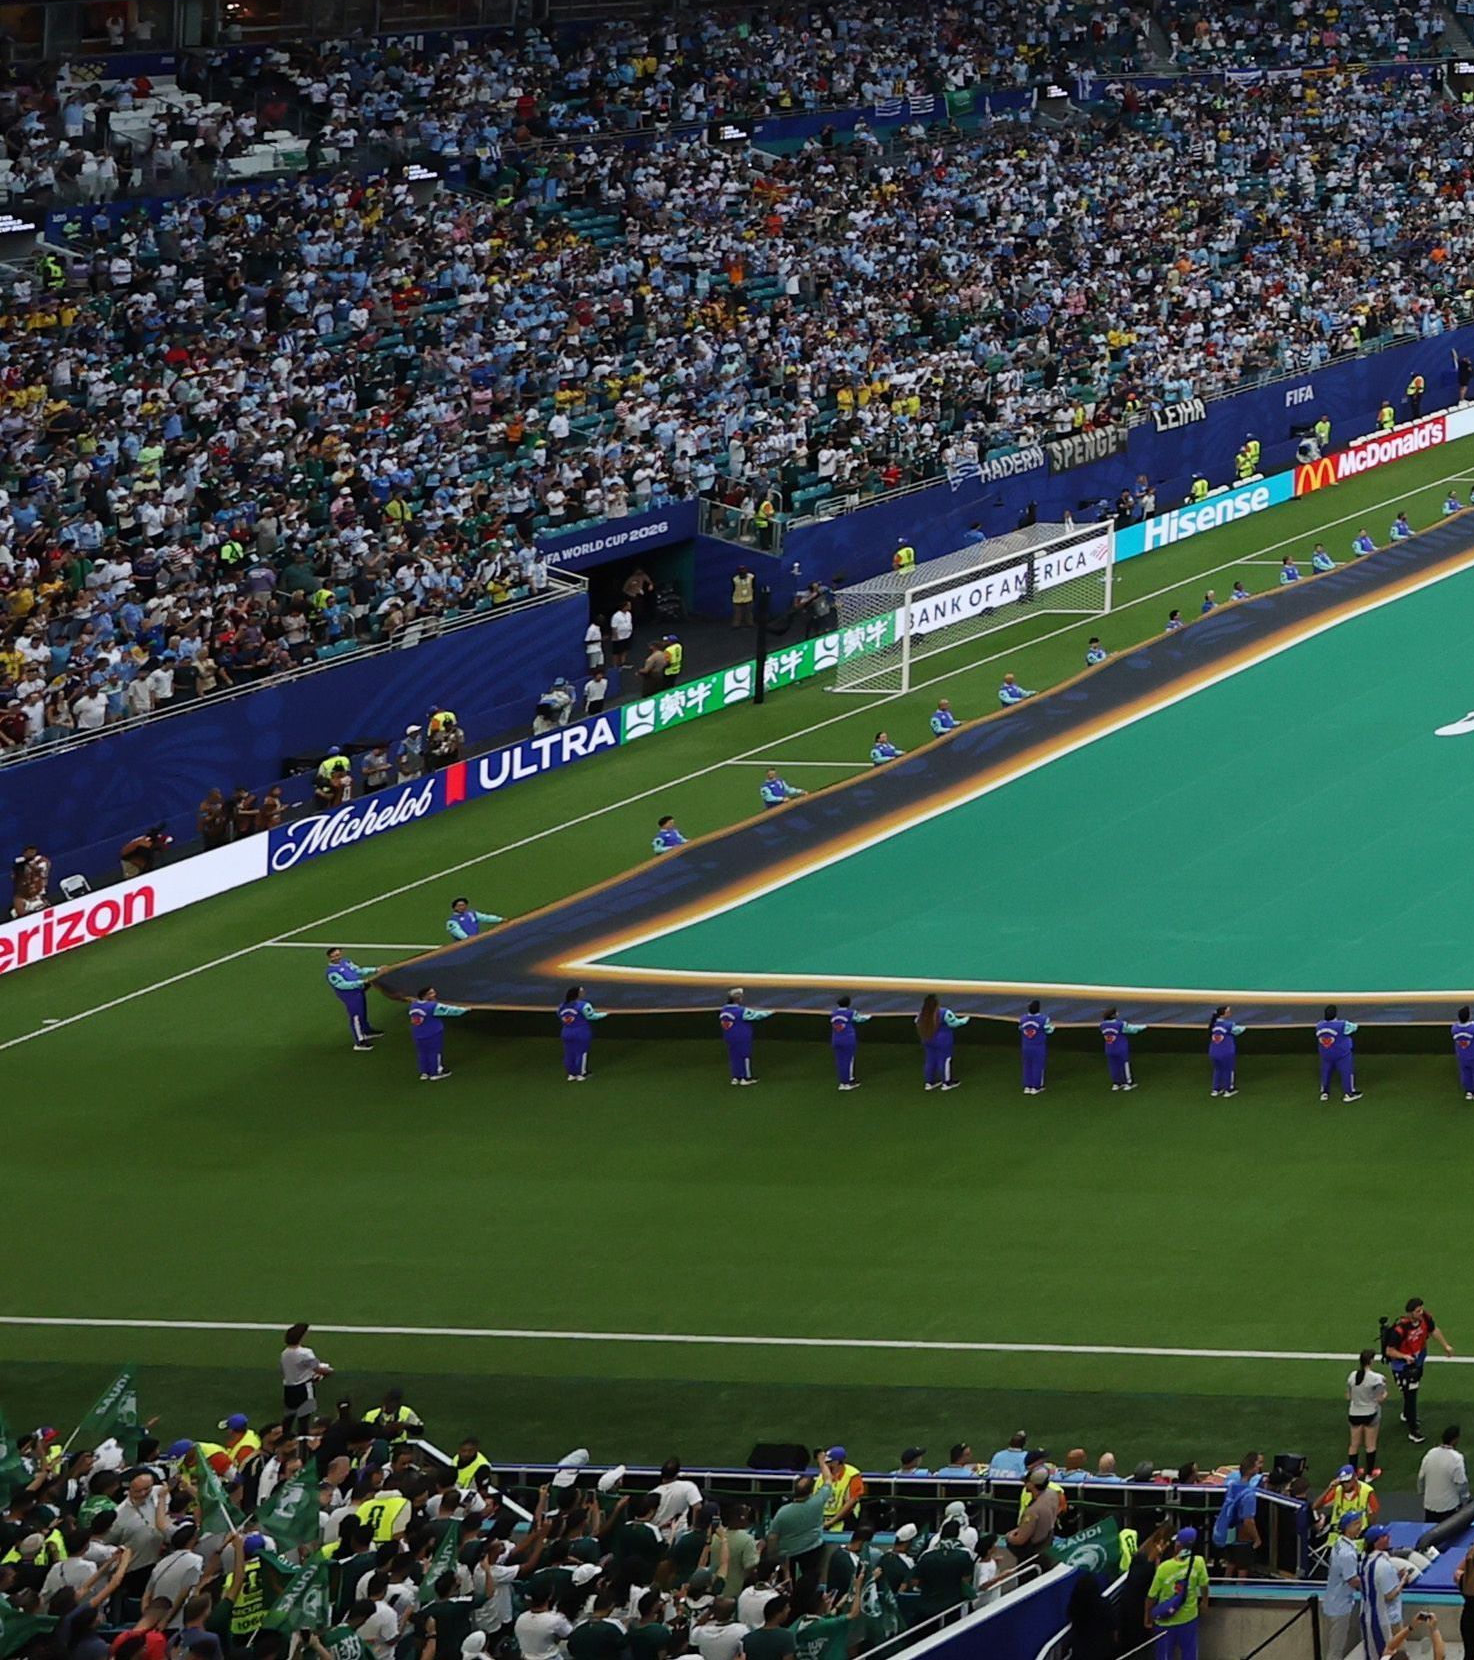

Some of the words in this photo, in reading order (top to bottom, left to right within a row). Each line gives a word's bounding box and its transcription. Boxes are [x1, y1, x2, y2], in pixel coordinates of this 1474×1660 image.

[1284, 384, 1315, 407] FIFA
[1337, 416, 1446, 480] McDonald's
[1143, 485, 1269, 552] Hisense
[561, 538, 604, 562] WORLD
[604, 531, 630, 551] CUP
[629, 521, 669, 543] 2026
[969, 581, 996, 608] OF
[271, 777, 433, 872] Michelob
[478, 716, 616, 790] ULTRA
[0, 886, 155, 976] erizon
[95, 1374, 130, 1417] SAUDI
[1056, 1525, 1103, 1550] SAUDI
